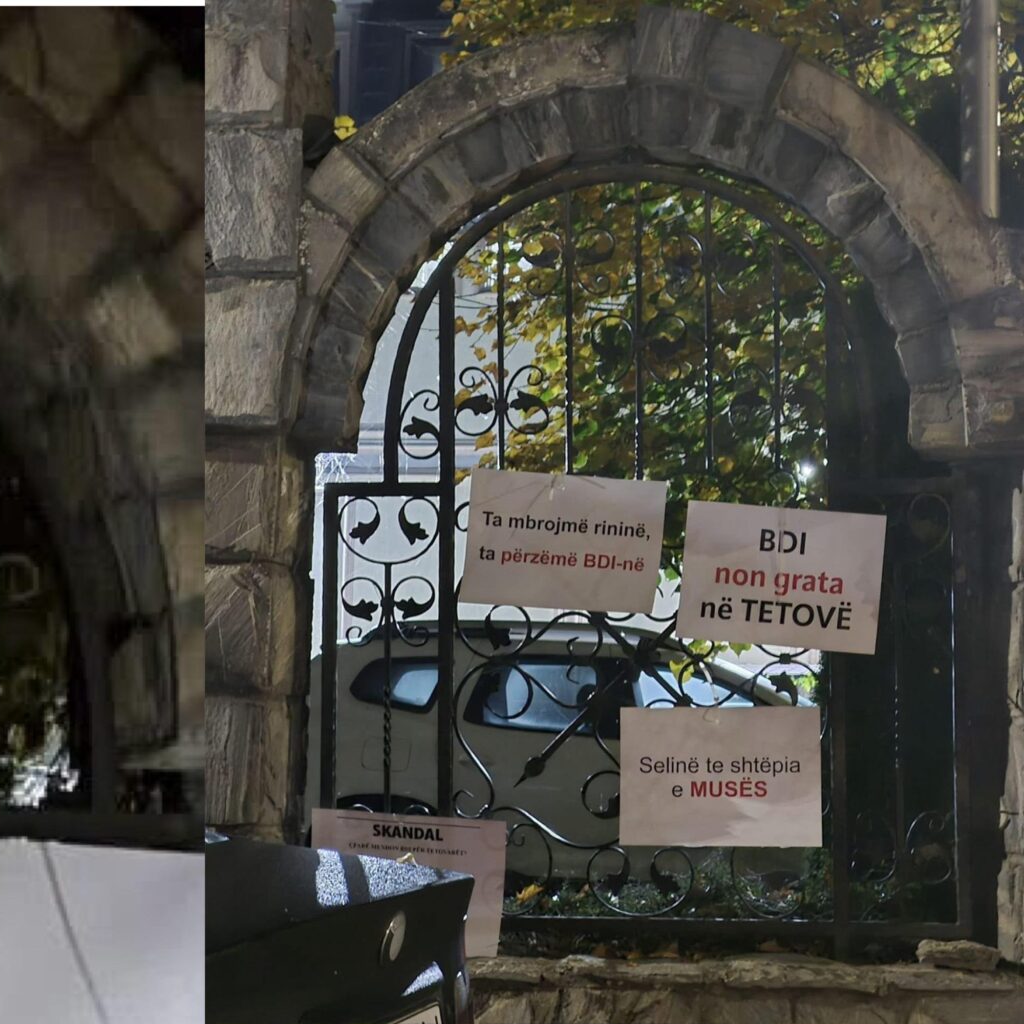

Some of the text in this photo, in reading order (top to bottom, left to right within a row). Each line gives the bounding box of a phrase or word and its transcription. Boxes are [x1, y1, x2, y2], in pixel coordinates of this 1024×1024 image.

[482, 511, 651, 541] Ta mbrojmë rininë,
[759, 528, 807, 555] BDI
[479, 545, 645, 572] ta përzëmë BDI-në
[715, 566, 844, 596] non grata
[700, 597, 853, 630] në TETOVË
[639, 756, 801, 777] Selinë te shtëpia
[672, 777, 768, 798] e MUSËS
[372, 823, 444, 841] SKANDAL
